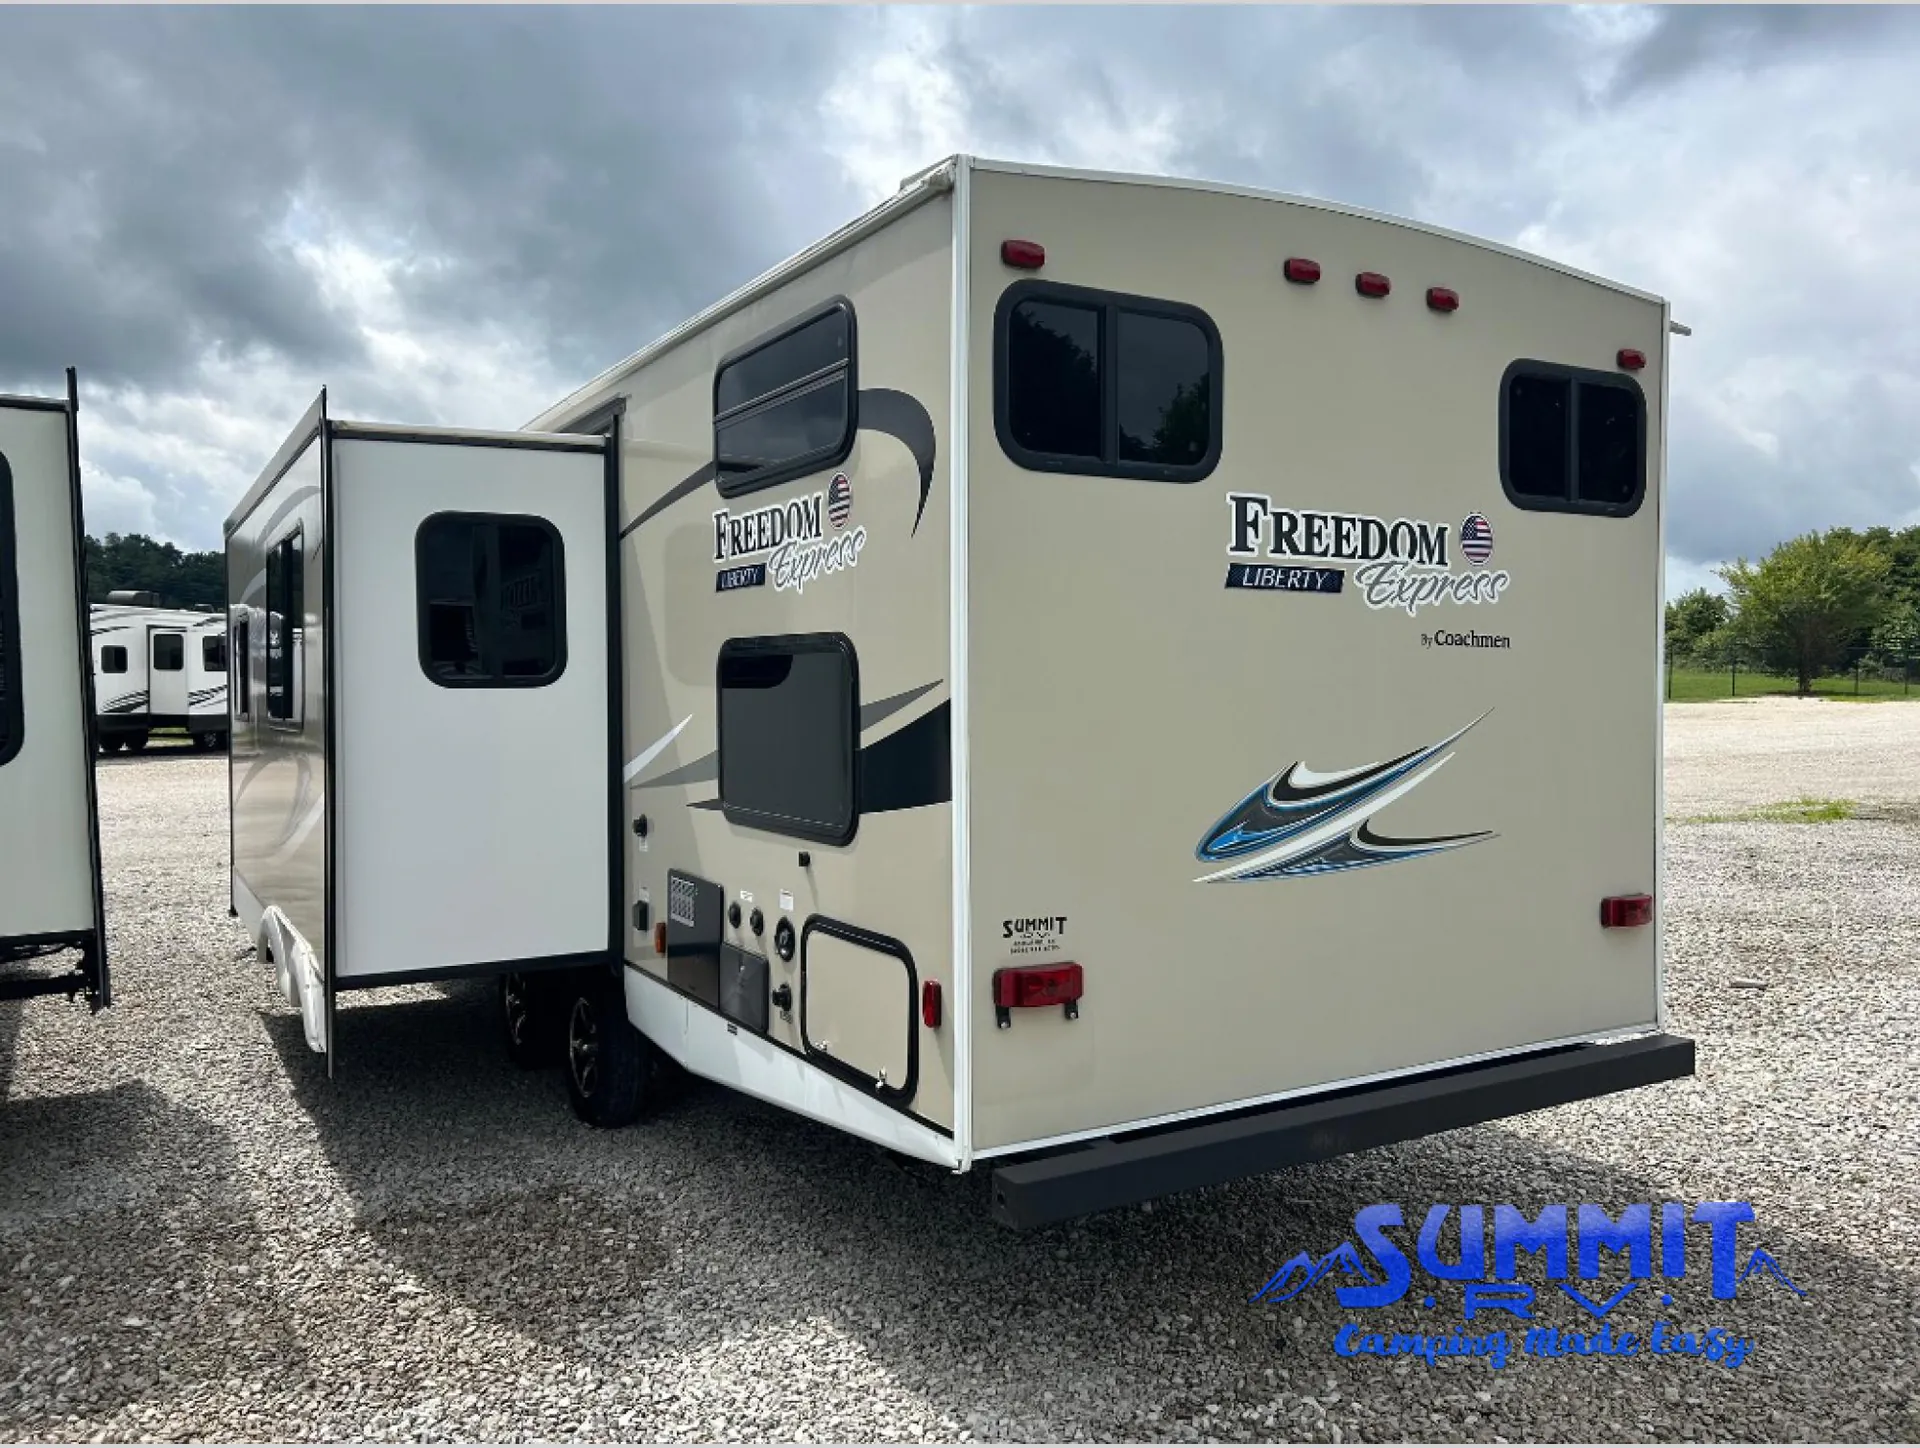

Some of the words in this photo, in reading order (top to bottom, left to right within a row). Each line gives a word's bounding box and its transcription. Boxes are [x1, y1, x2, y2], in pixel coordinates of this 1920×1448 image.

[713, 493, 824, 562] FREEDOM
[1228, 493, 1449, 567] FREEDOM
[721, 567, 758, 589] LIBERTY
[768, 527, 866, 592] Express
[1242, 567, 1329, 590] LIBERTY
[1354, 560, 1509, 615] Express
[1434, 629, 1511, 649] Coachmen
[1002, 916, 1068, 939] SUMMIT
